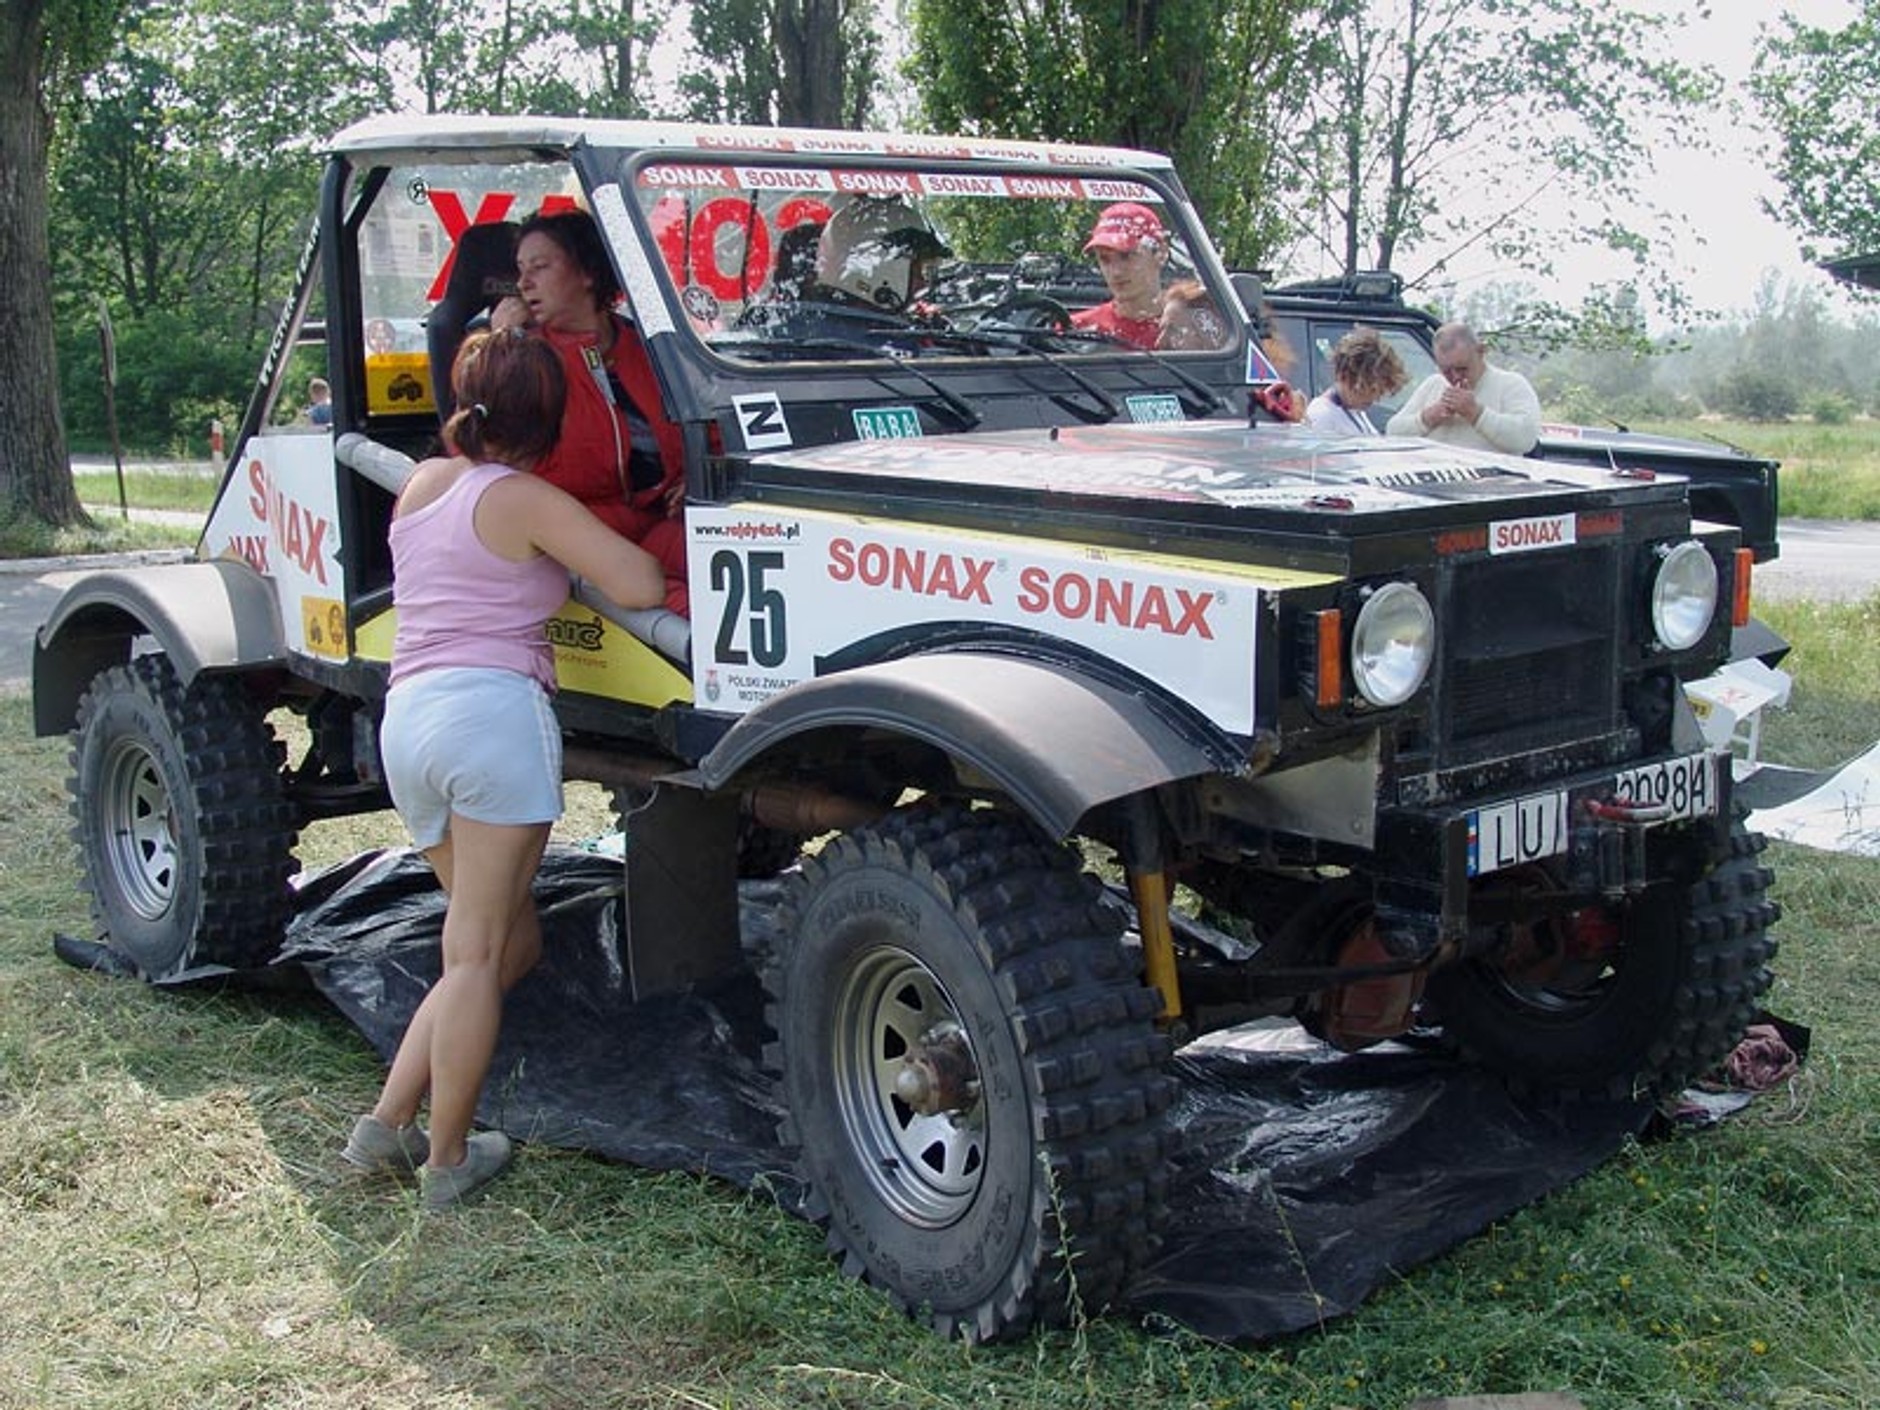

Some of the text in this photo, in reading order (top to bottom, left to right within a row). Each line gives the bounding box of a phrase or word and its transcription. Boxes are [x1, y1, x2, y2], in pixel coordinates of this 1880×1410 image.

[644, 166, 1151, 199] SONAX SONAX SONAX SONAX SONAX SONAX
[1497, 521, 1562, 548] SONAX
[710, 549, 788, 668] 25
